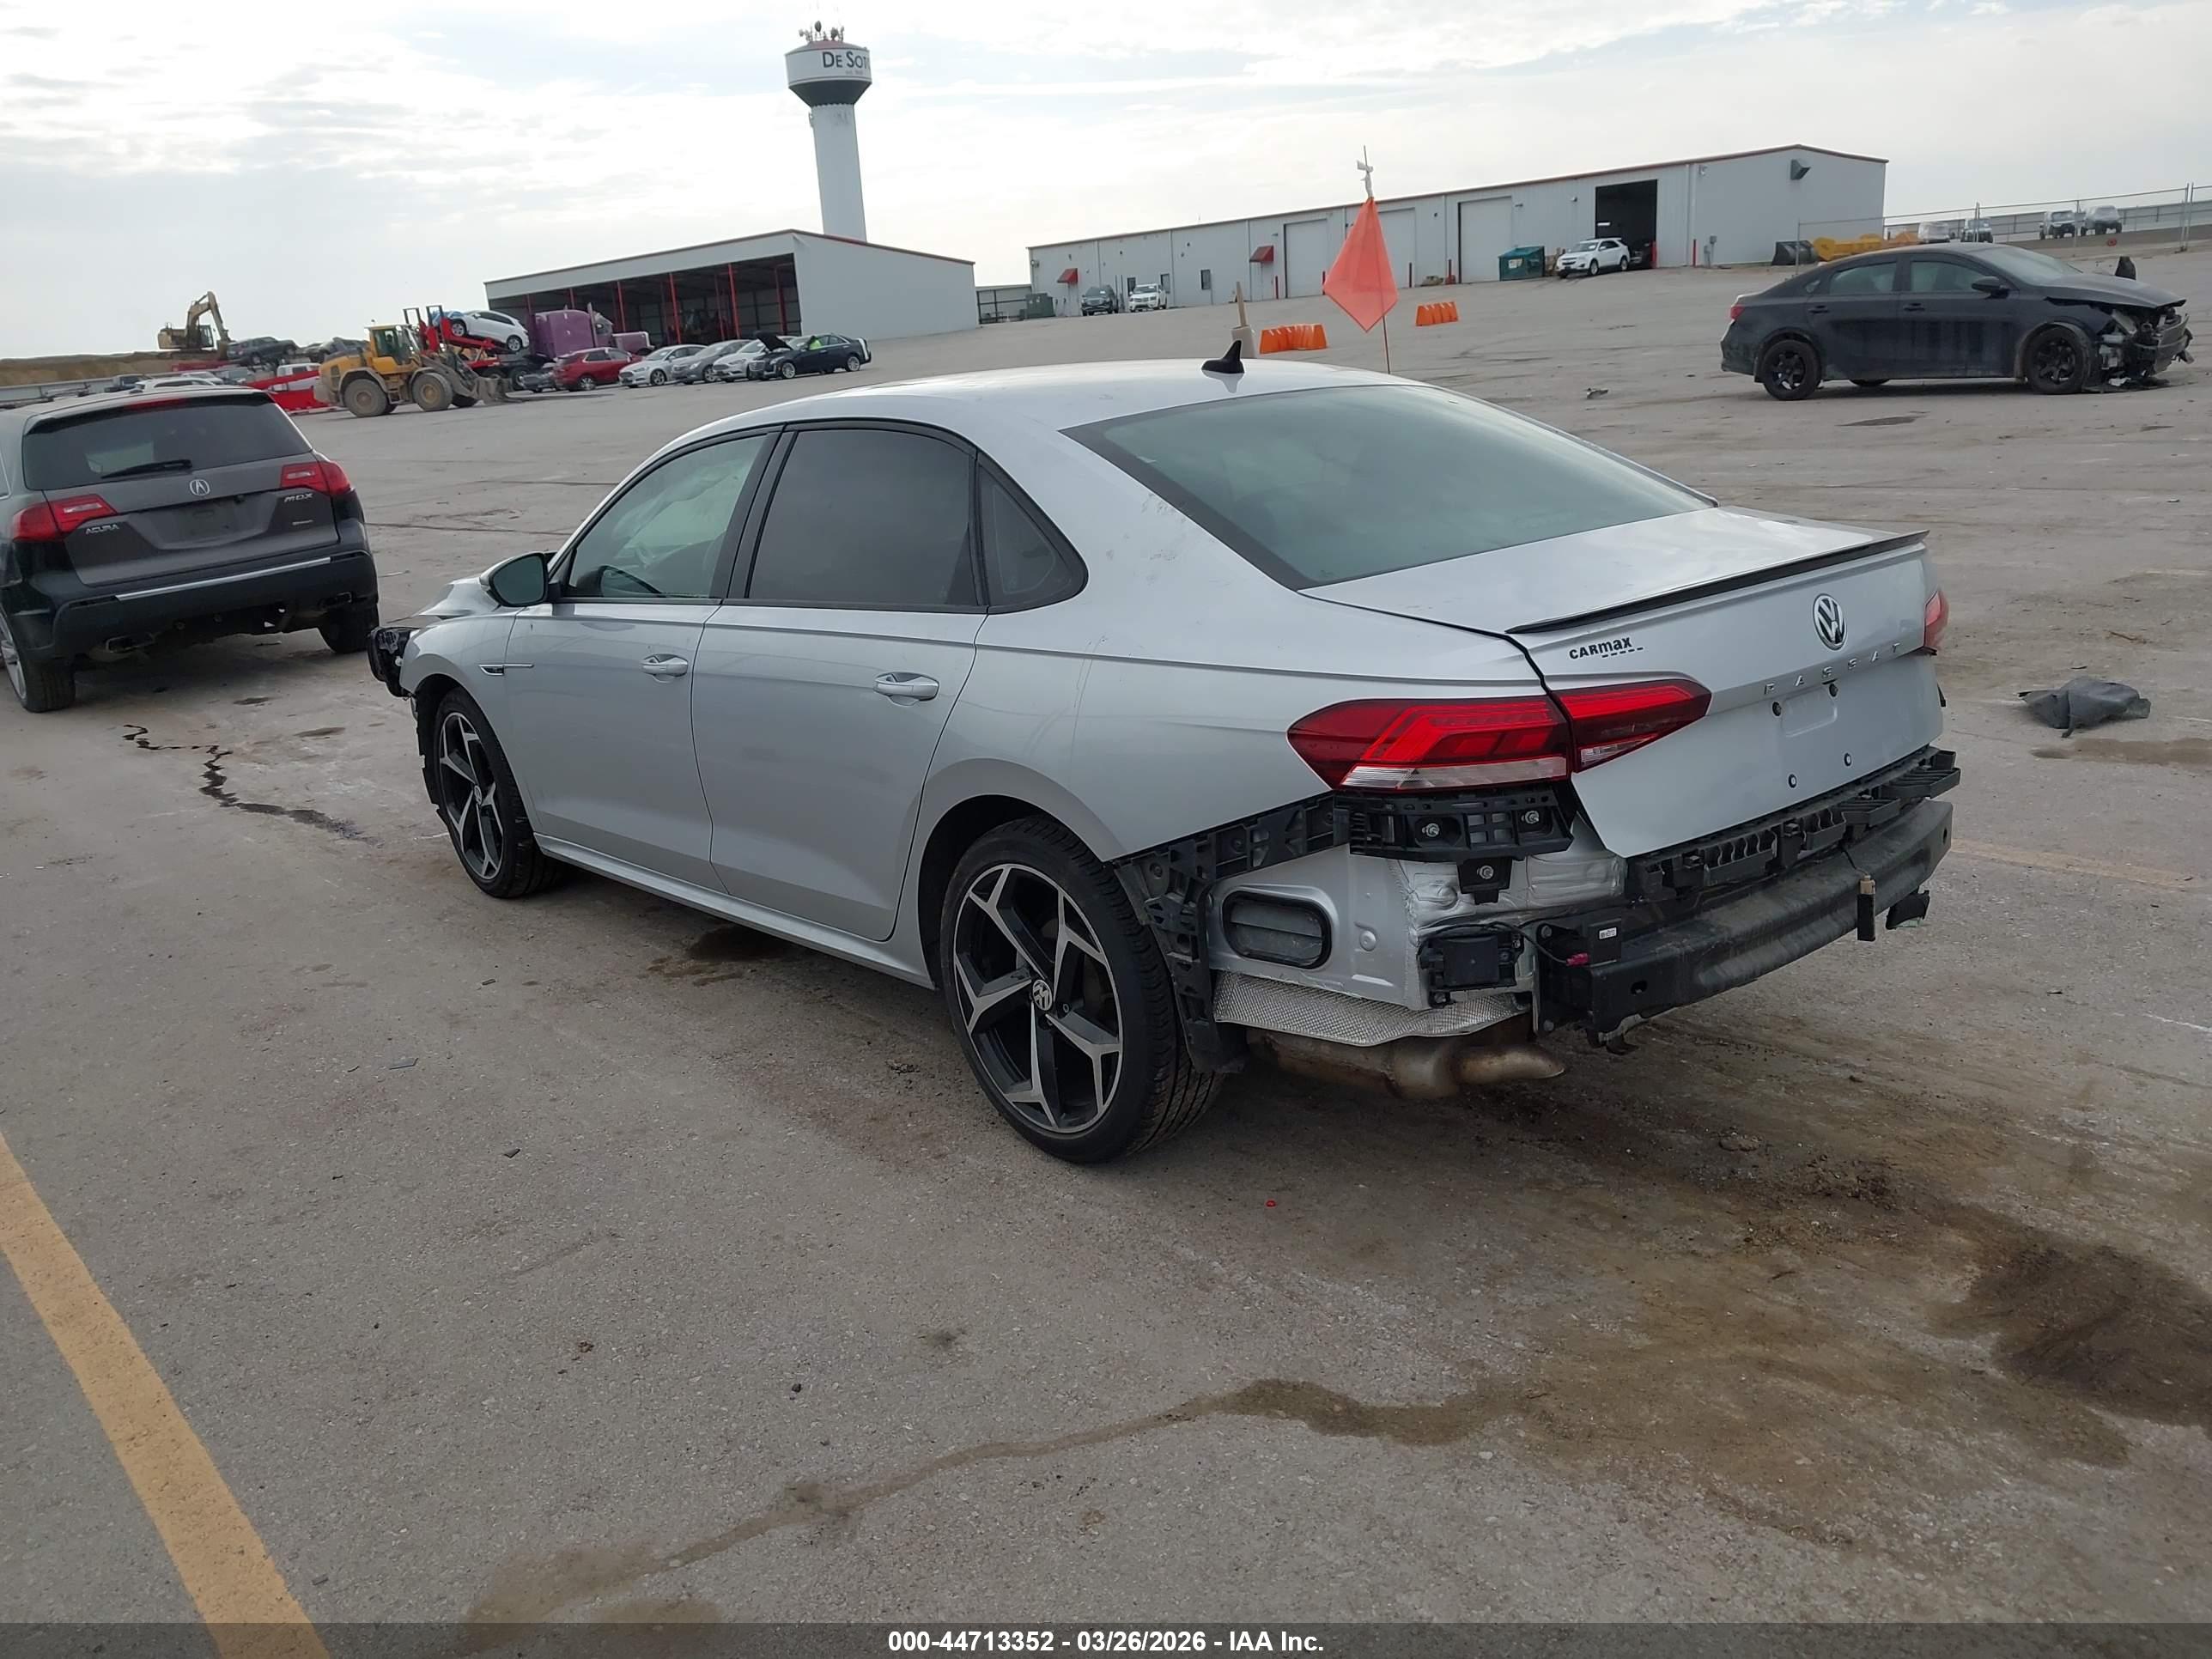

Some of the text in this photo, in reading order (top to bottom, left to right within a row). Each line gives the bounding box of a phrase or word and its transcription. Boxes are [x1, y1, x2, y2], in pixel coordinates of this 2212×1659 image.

[283, 492, 313, 503] MDX
[85, 524, 119, 535] ACURA
[1764, 642, 1901, 695] PASSAT
